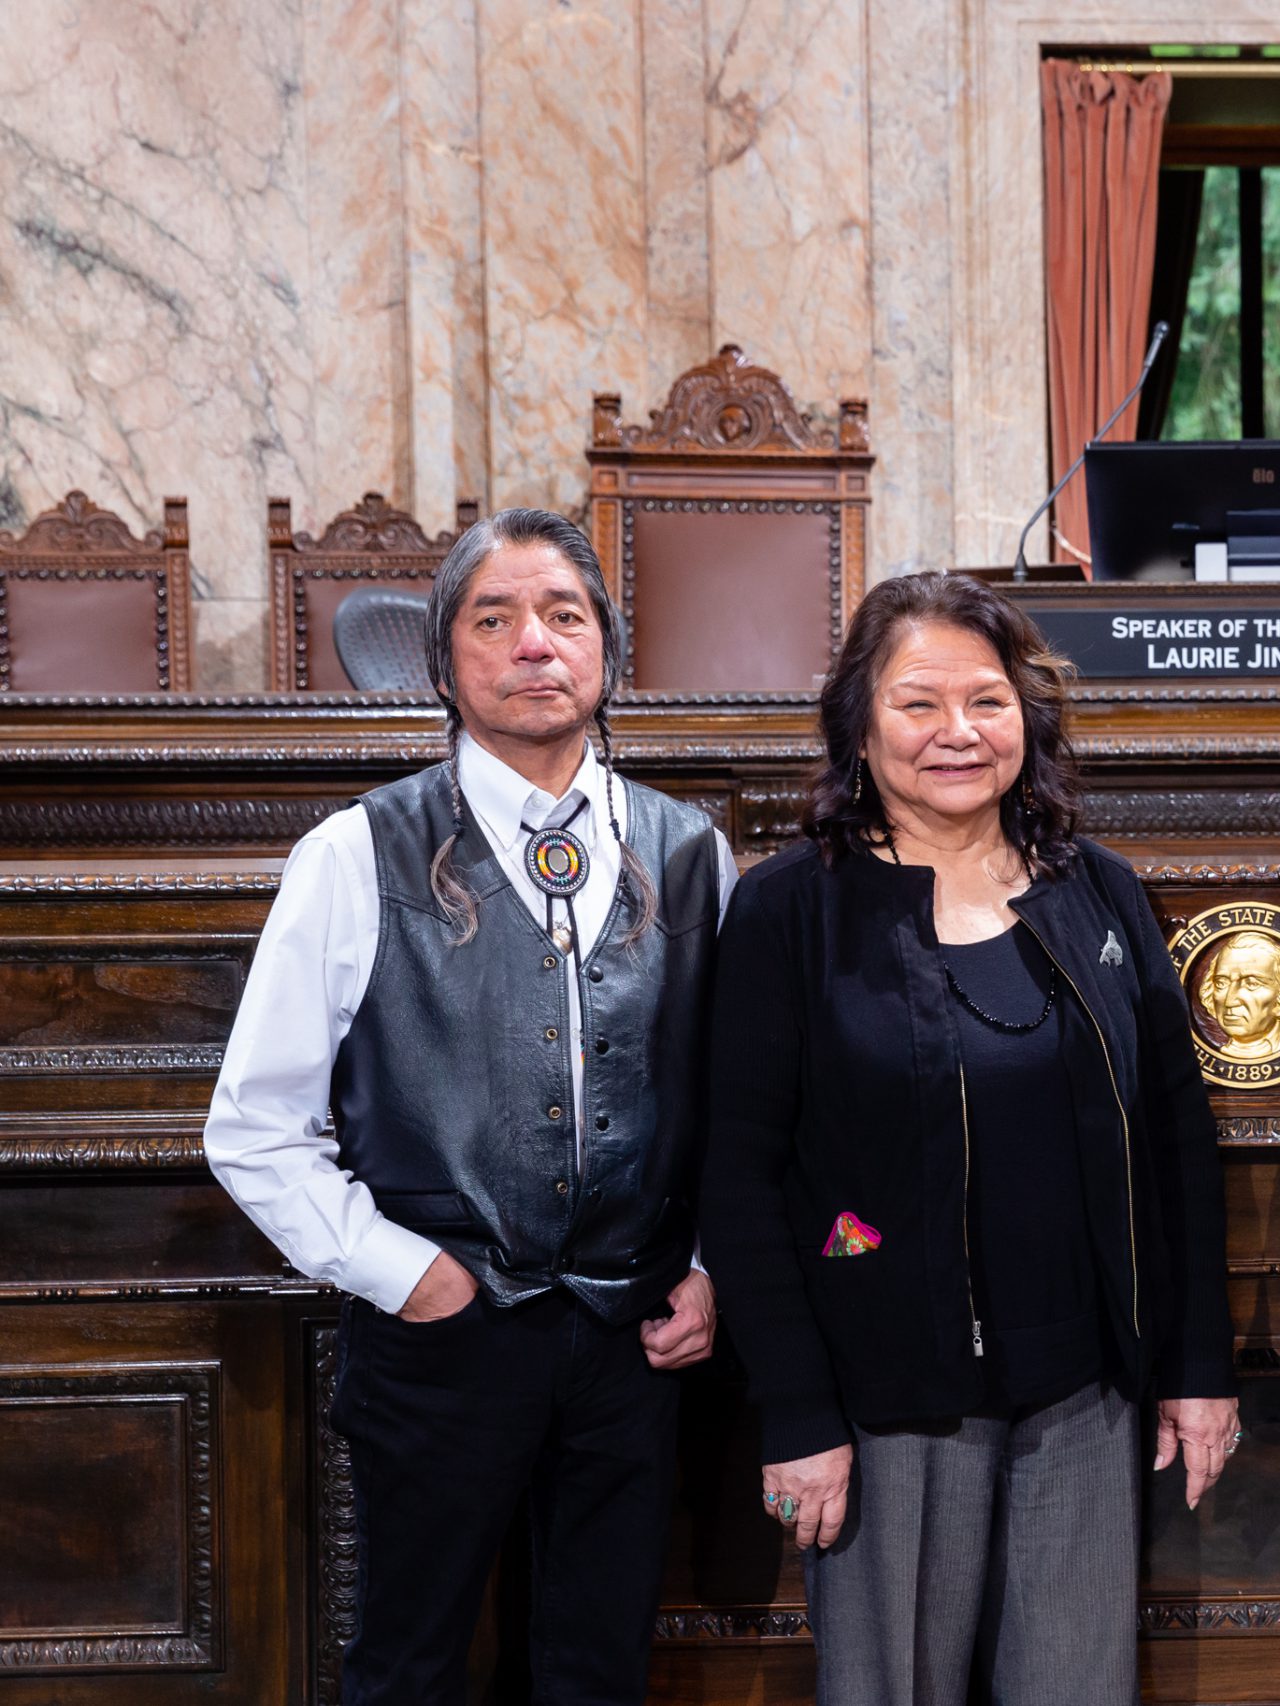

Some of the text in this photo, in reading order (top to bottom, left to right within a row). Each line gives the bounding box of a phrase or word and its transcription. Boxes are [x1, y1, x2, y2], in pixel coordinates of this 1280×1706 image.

[1111, 617, 1211, 638] SPEAKER
[1218, 619, 1247, 638] OF
[1147, 644, 1239, 669] LAURIE
[1177, 921, 1212, 951] THE
[1218, 908, 1275, 927] STATE
[1227, 1064, 1272, 1080] 1889
